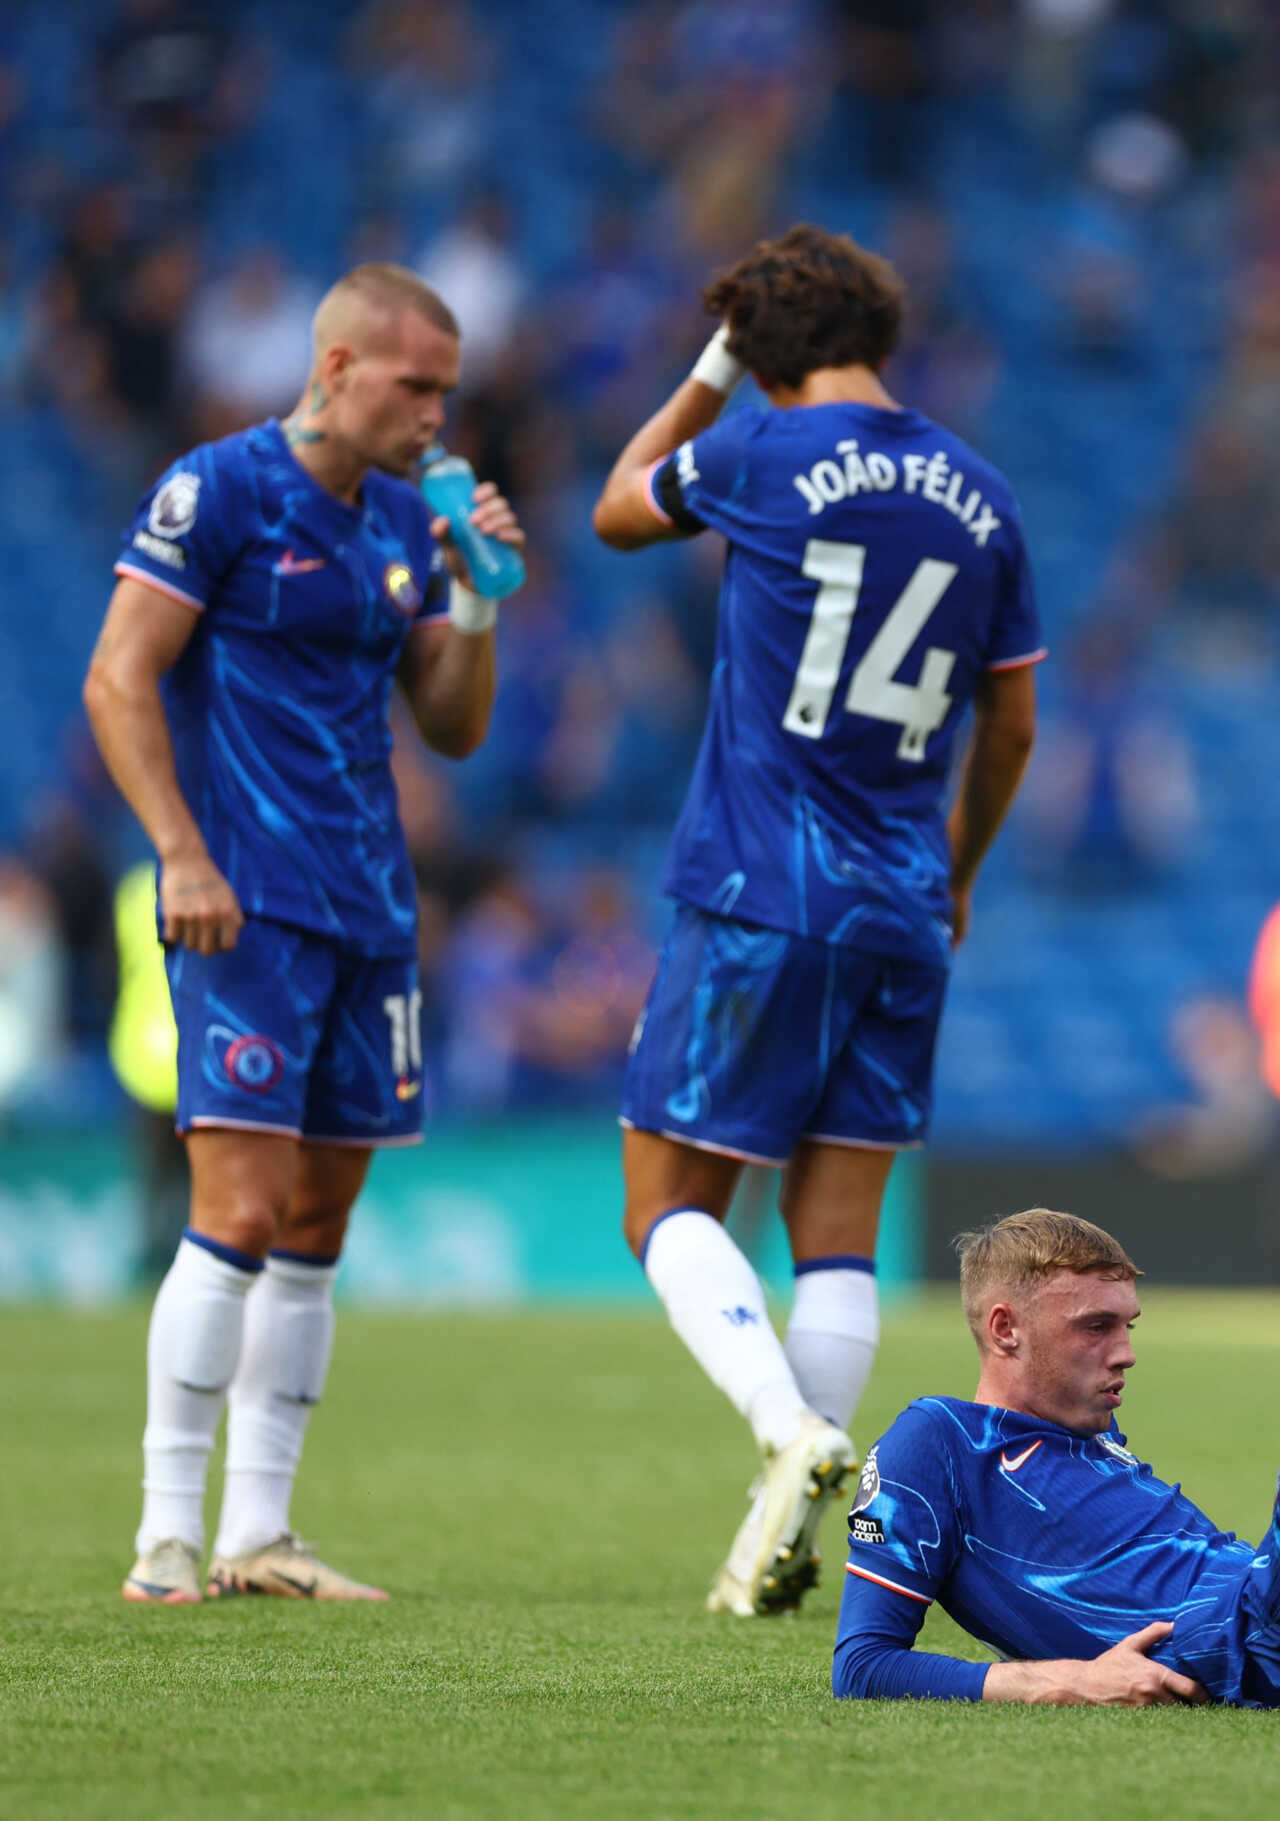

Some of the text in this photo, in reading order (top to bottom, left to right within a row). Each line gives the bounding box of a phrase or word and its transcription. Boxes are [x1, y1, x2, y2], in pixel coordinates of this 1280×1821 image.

[794, 440, 897, 514] JOÃO
[902, 452, 1000, 546] FÉLIX
[782, 539, 959, 761] 14
